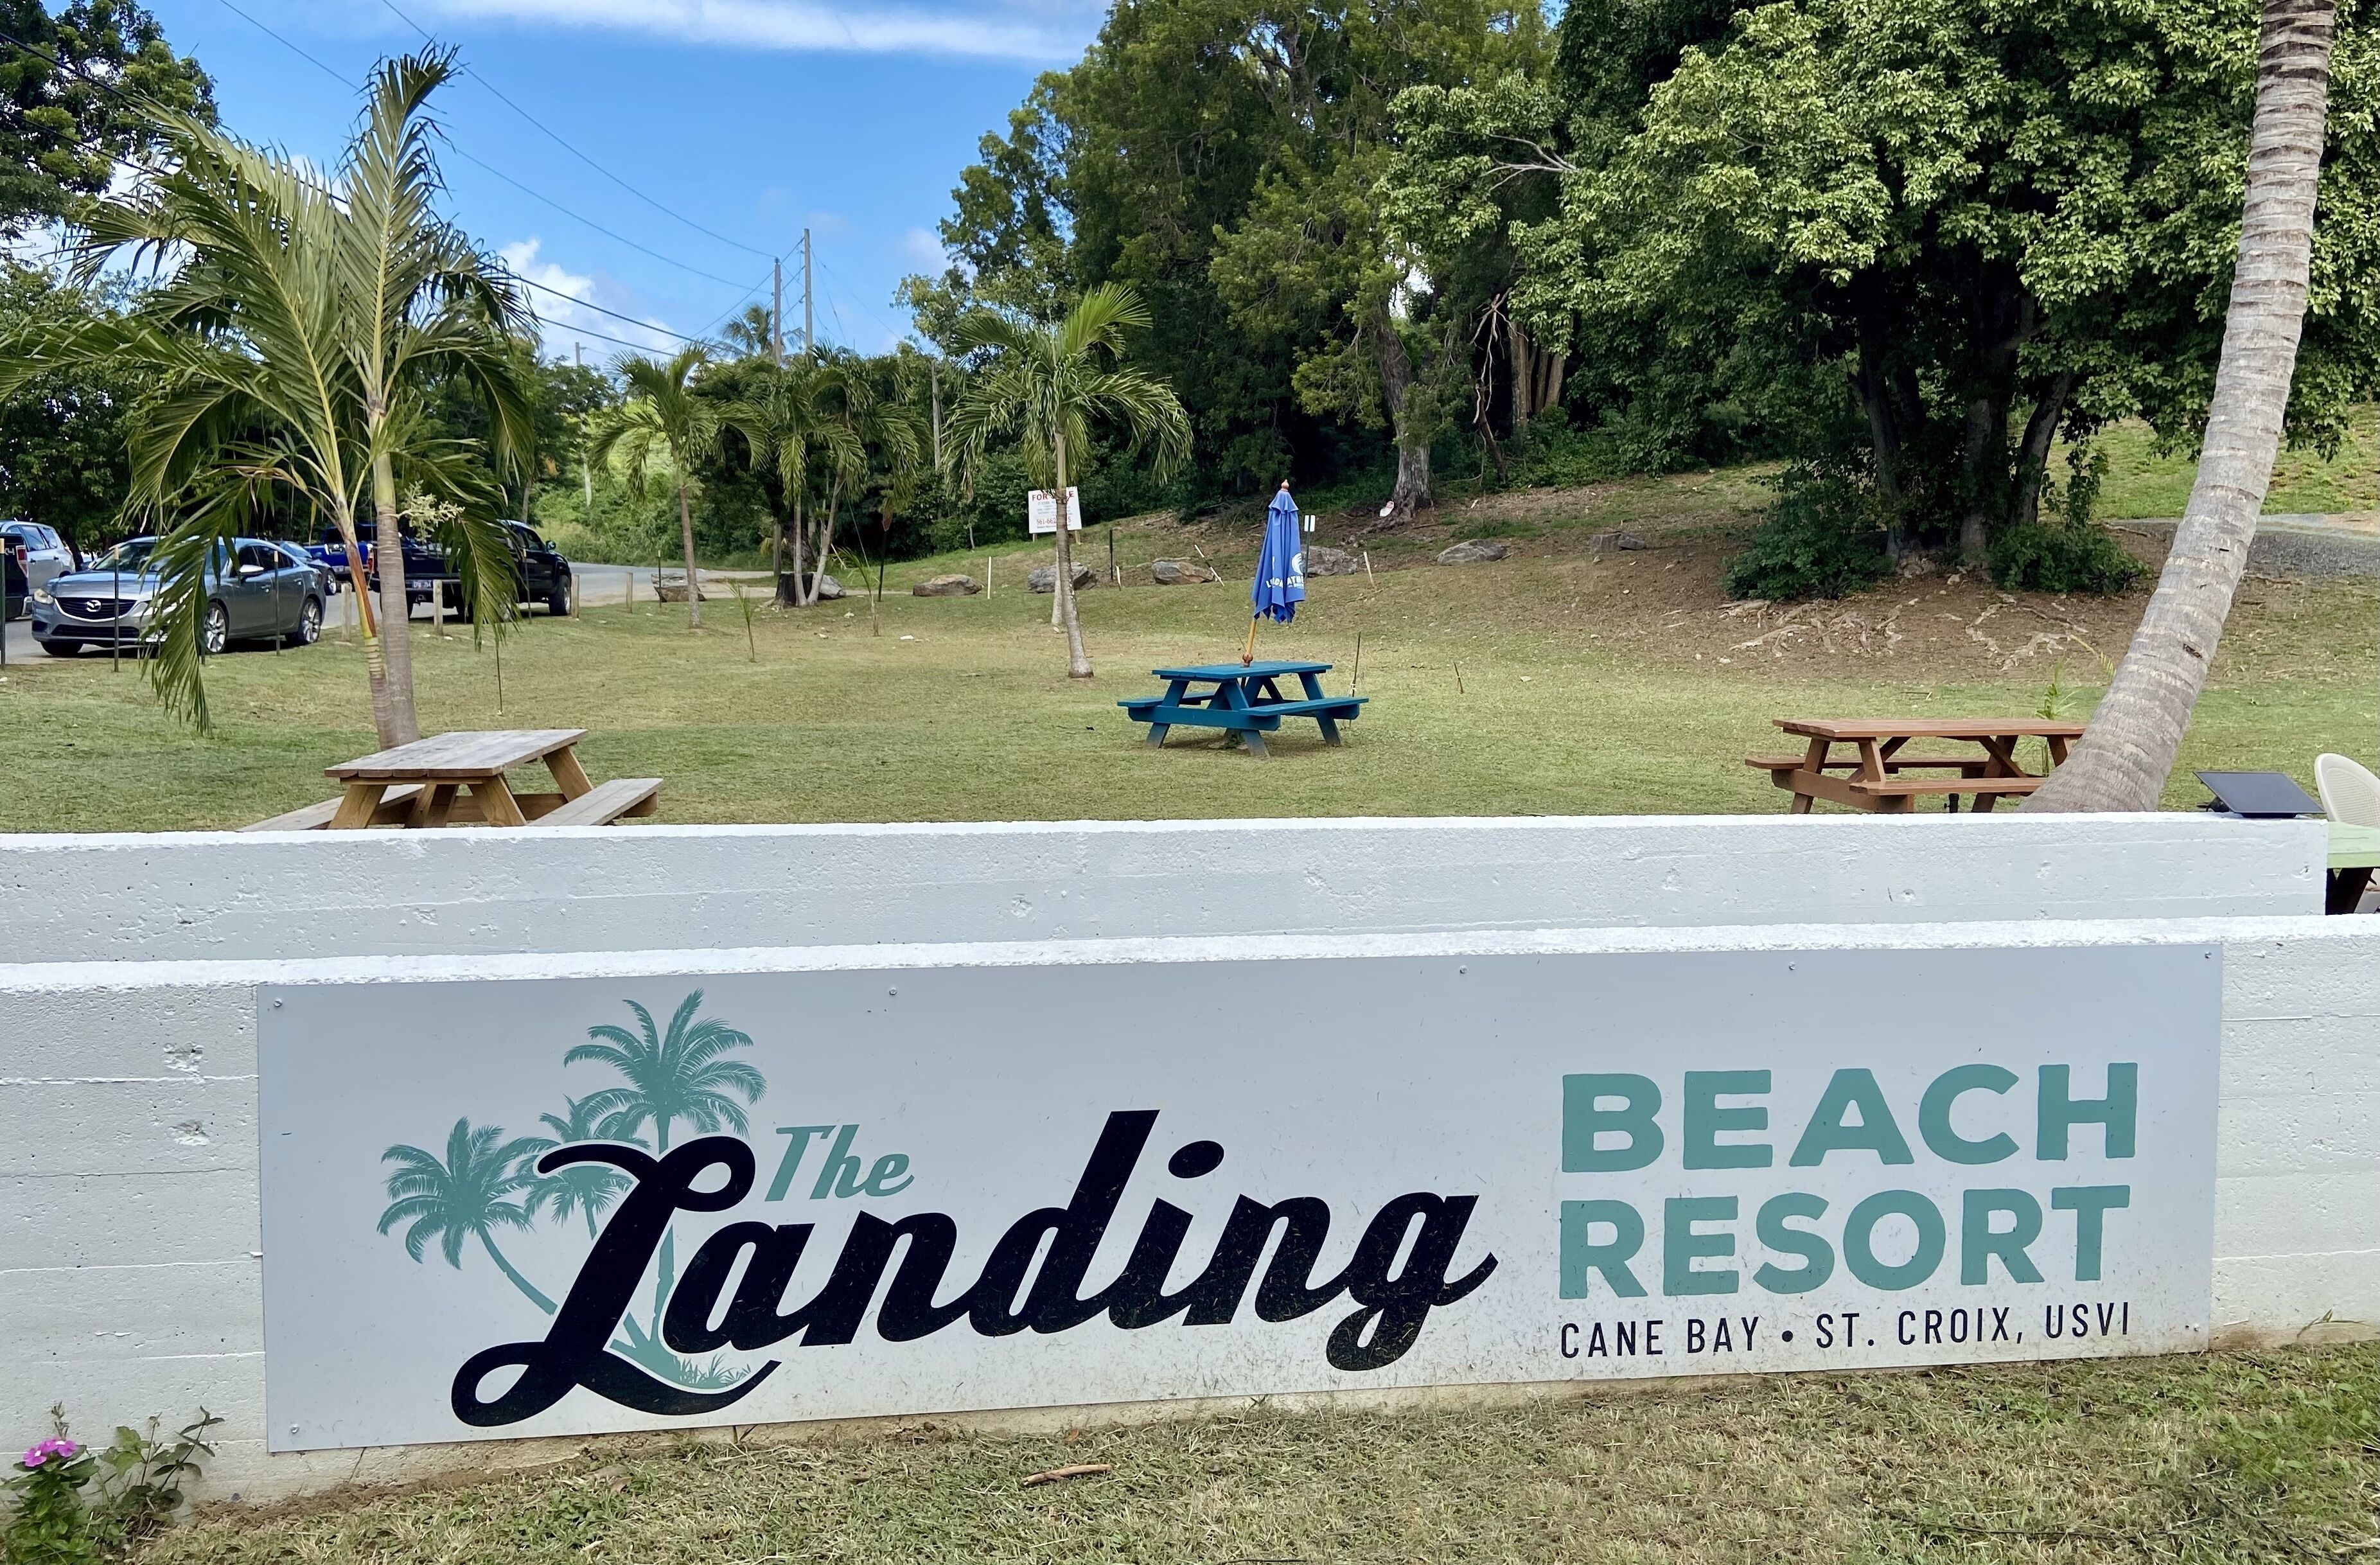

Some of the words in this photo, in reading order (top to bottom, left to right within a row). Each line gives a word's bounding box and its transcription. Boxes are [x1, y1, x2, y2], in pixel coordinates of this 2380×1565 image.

[1032, 493, 1048, 501] FOR
[764, 1123, 915, 1203] The
[1561, 1061, 2138, 1173] BEACH
[452, 1110, 1499, 1428] Landing
[1559, 1184, 2131, 1300] RESORT
[1560, 1320, 1664, 1359] CANE
[1688, 1316, 1759, 1354] BAY
[1816, 1313, 1875, 1348] ST.
[1898, 1307, 2023, 1345] CROIX,
[2046, 1302, 2129, 1339] USVI
